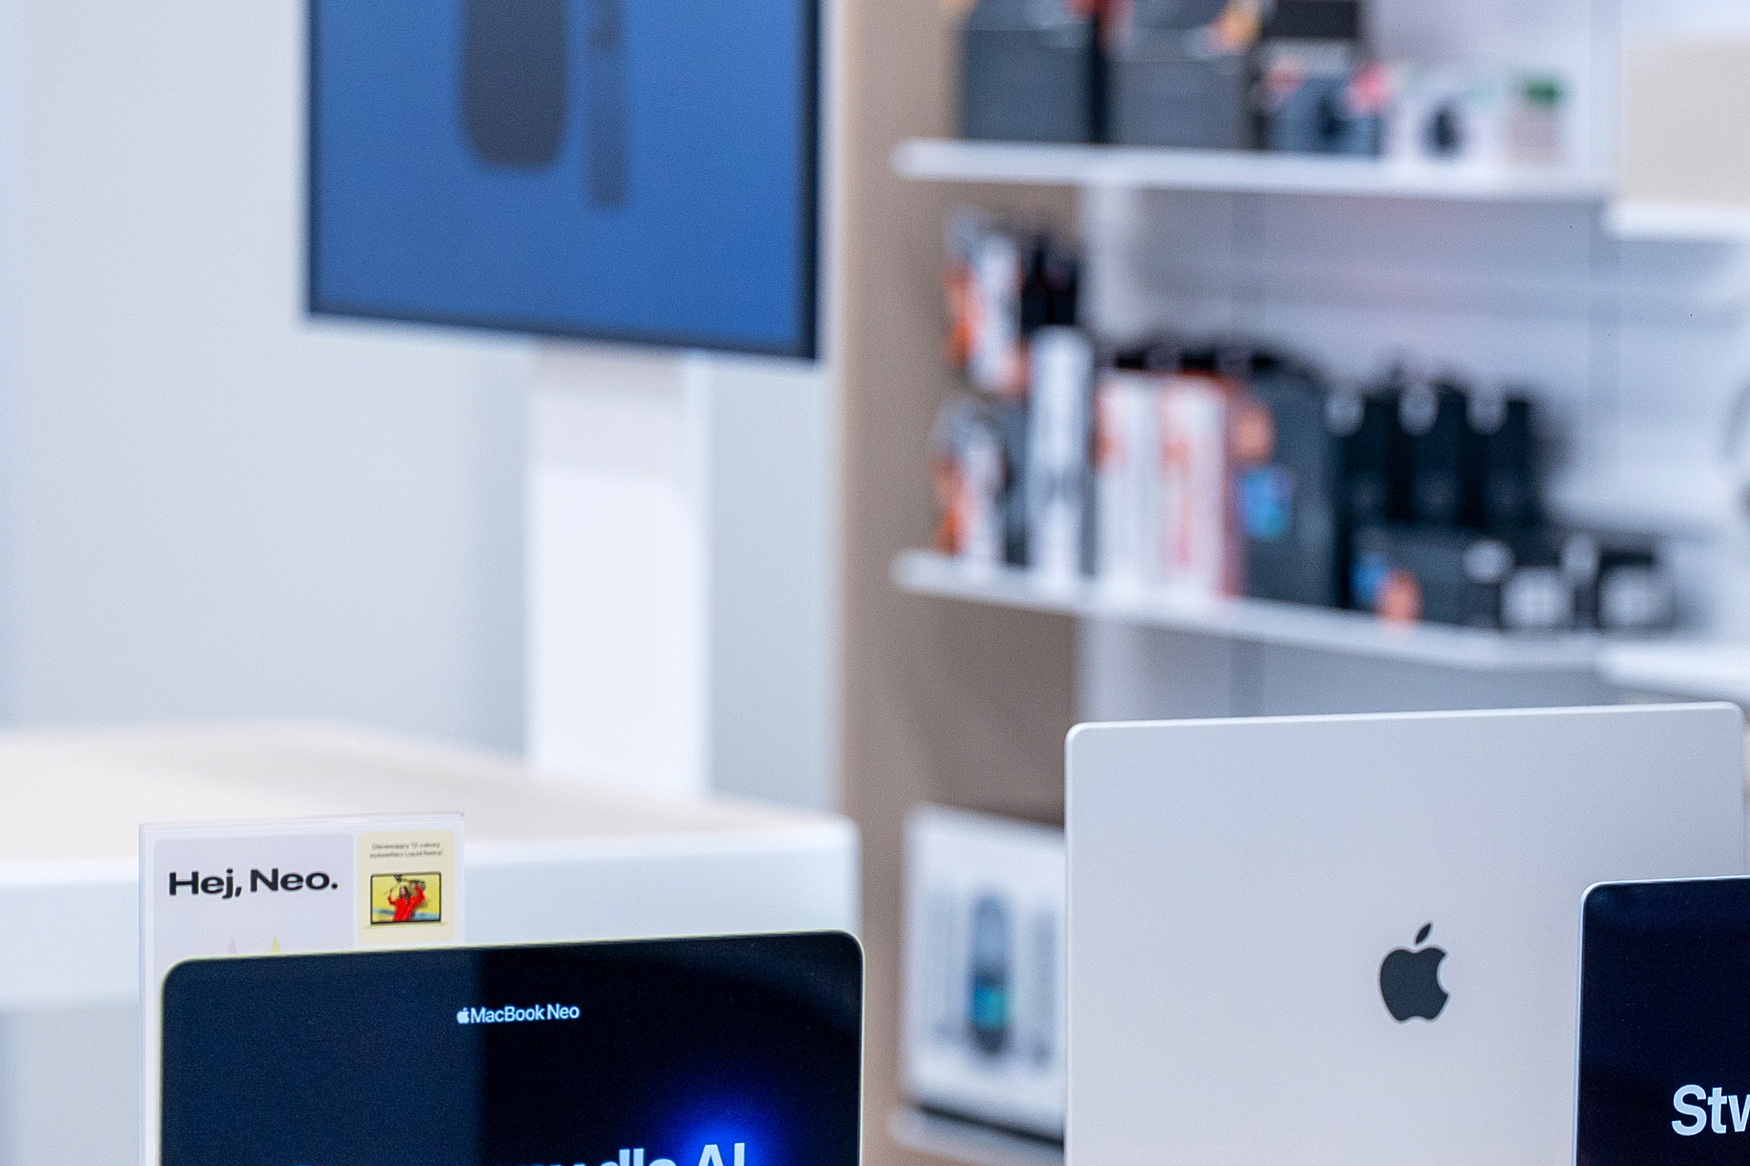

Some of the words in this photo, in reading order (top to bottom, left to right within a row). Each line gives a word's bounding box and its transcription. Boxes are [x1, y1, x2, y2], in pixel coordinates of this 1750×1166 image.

[169, 868, 242, 900] Hej,
[250, 868, 338, 893] Neo.
[470, 1004, 545, 1024] MacBook
[546, 1003, 580, 1020] Neo
